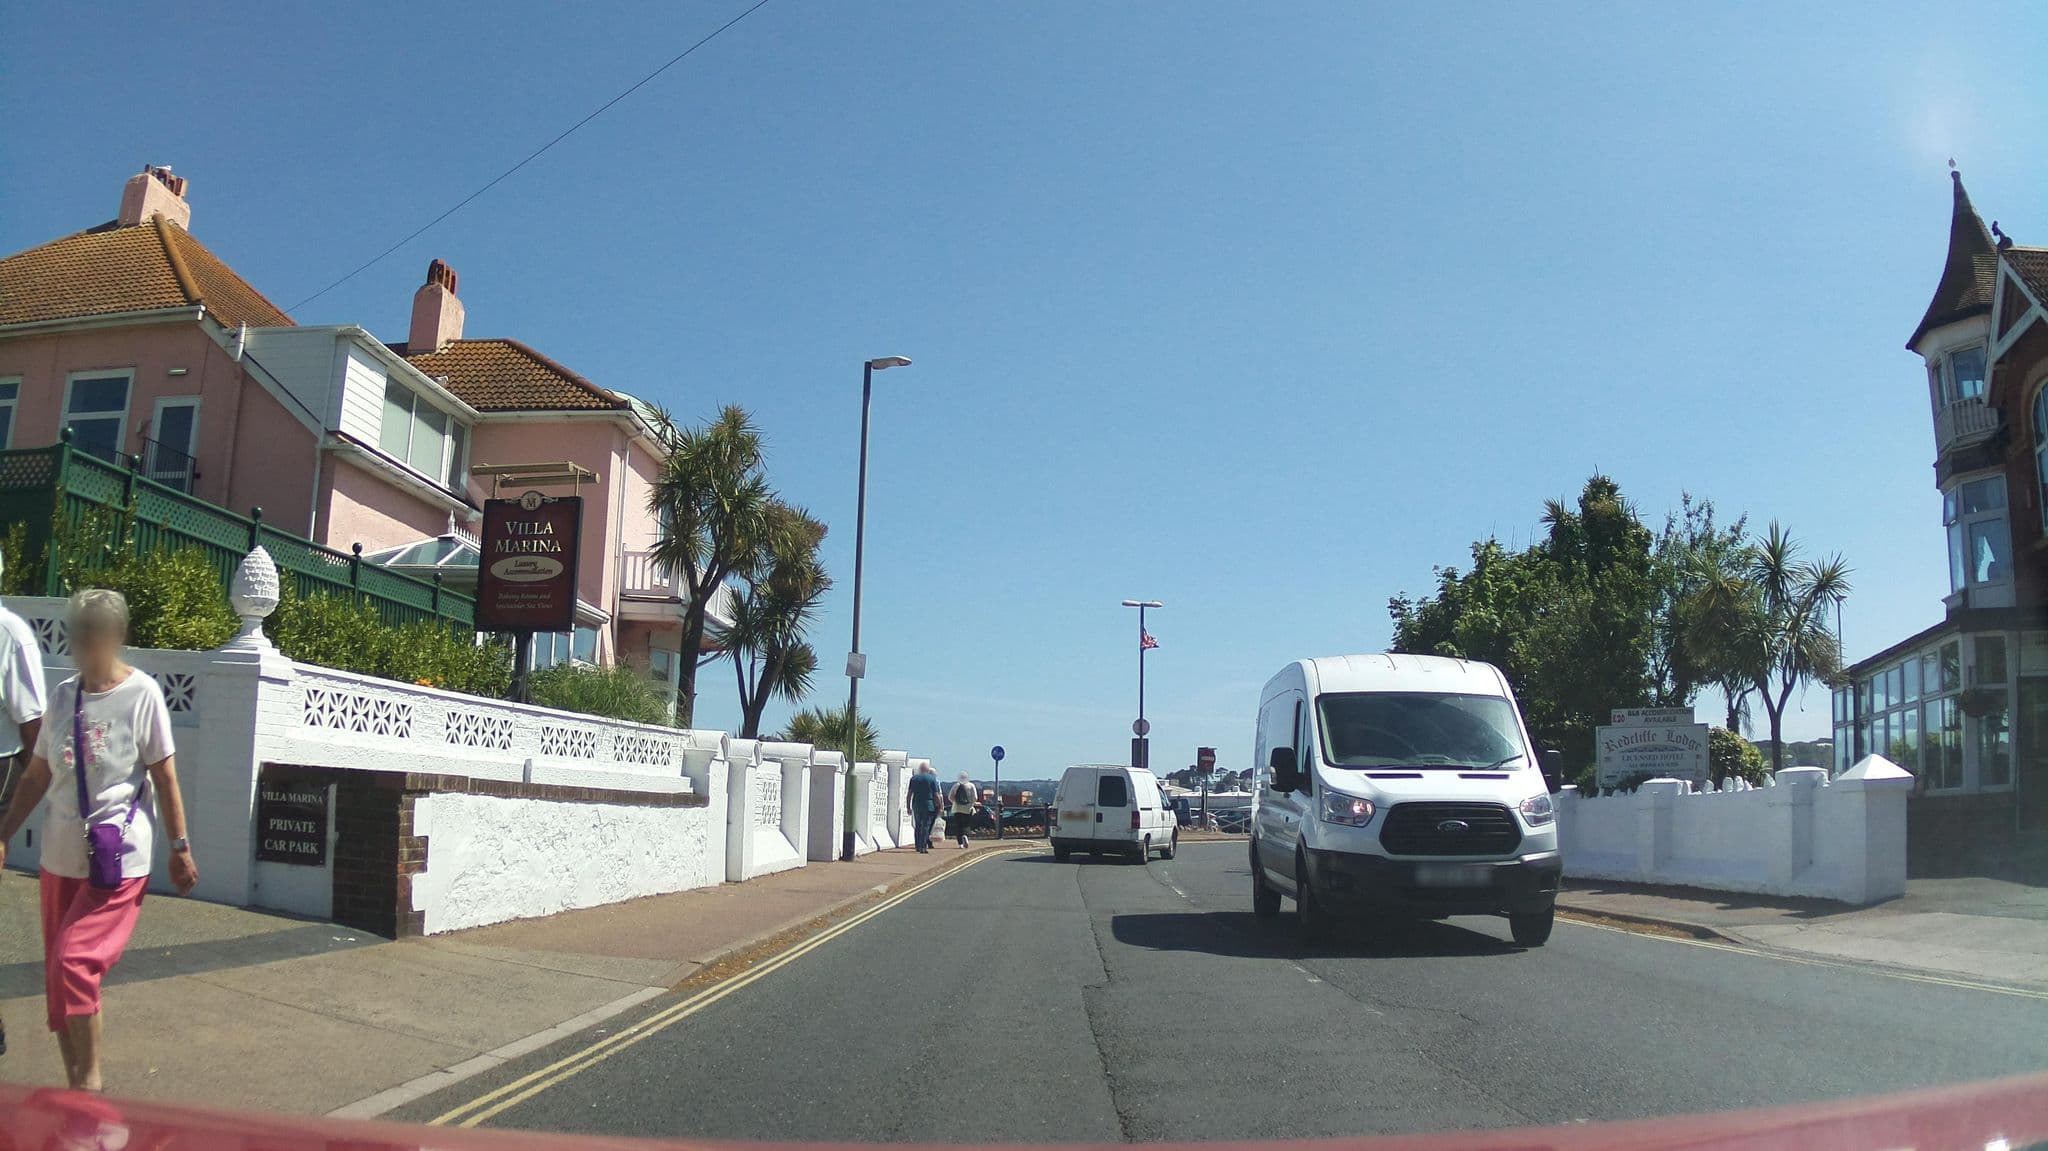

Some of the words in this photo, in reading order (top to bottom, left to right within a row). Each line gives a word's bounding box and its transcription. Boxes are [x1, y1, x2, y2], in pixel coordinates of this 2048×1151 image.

[505, 521, 554, 535] VILLA
[495, 539, 562, 553] MARINA
[1605, 729, 1657, 752] Redcliffe
[1666, 729, 1702, 752] Lodge
[262, 791, 287, 802] VILLA
[288, 793, 323, 804] MARINA
[269, 818, 316, 833] PRIVATE
[264, 839, 287, 851] CAR
[289, 841, 320, 854] PARK
